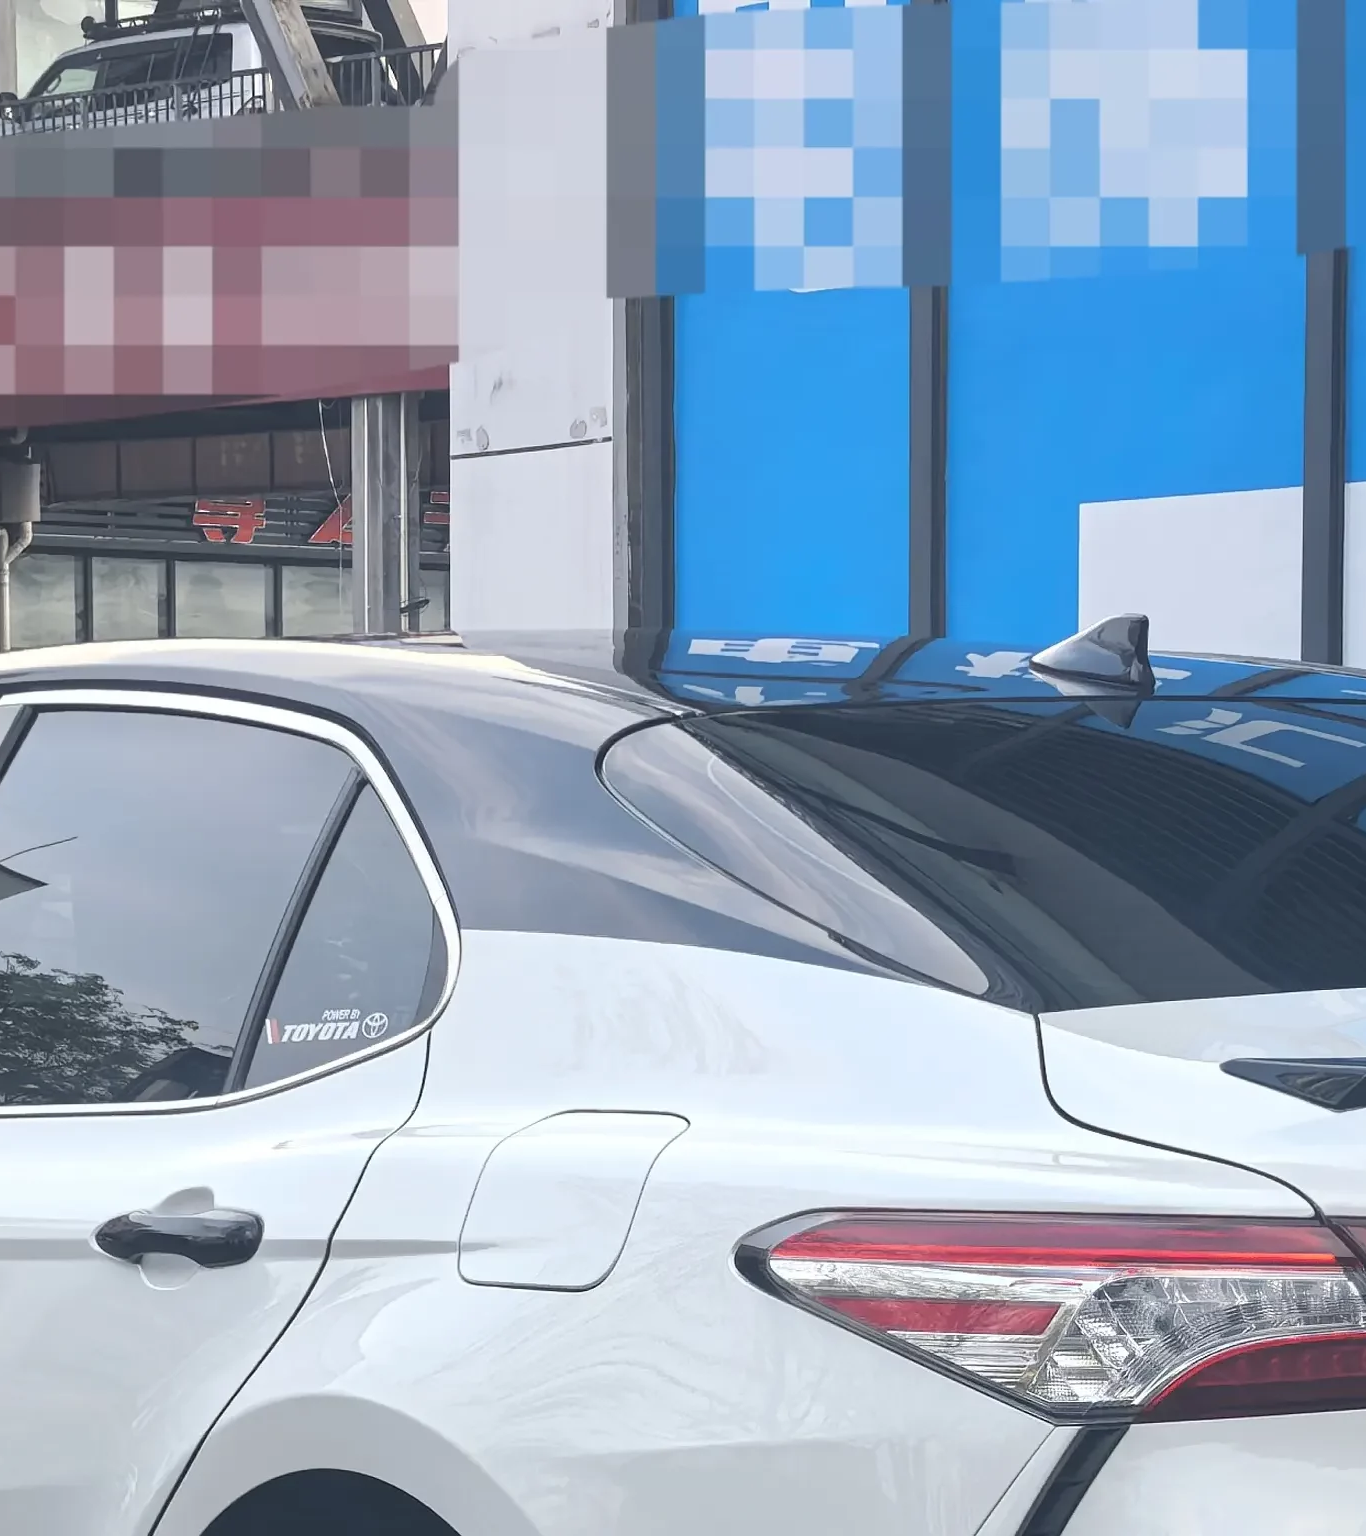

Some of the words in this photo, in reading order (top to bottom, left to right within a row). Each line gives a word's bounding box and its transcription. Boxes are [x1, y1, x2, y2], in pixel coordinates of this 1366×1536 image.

[321, 1009, 350, 1021] POWER
[350, 1008, 361, 1020] BY
[281, 1020, 361, 1043] TOYOTA
